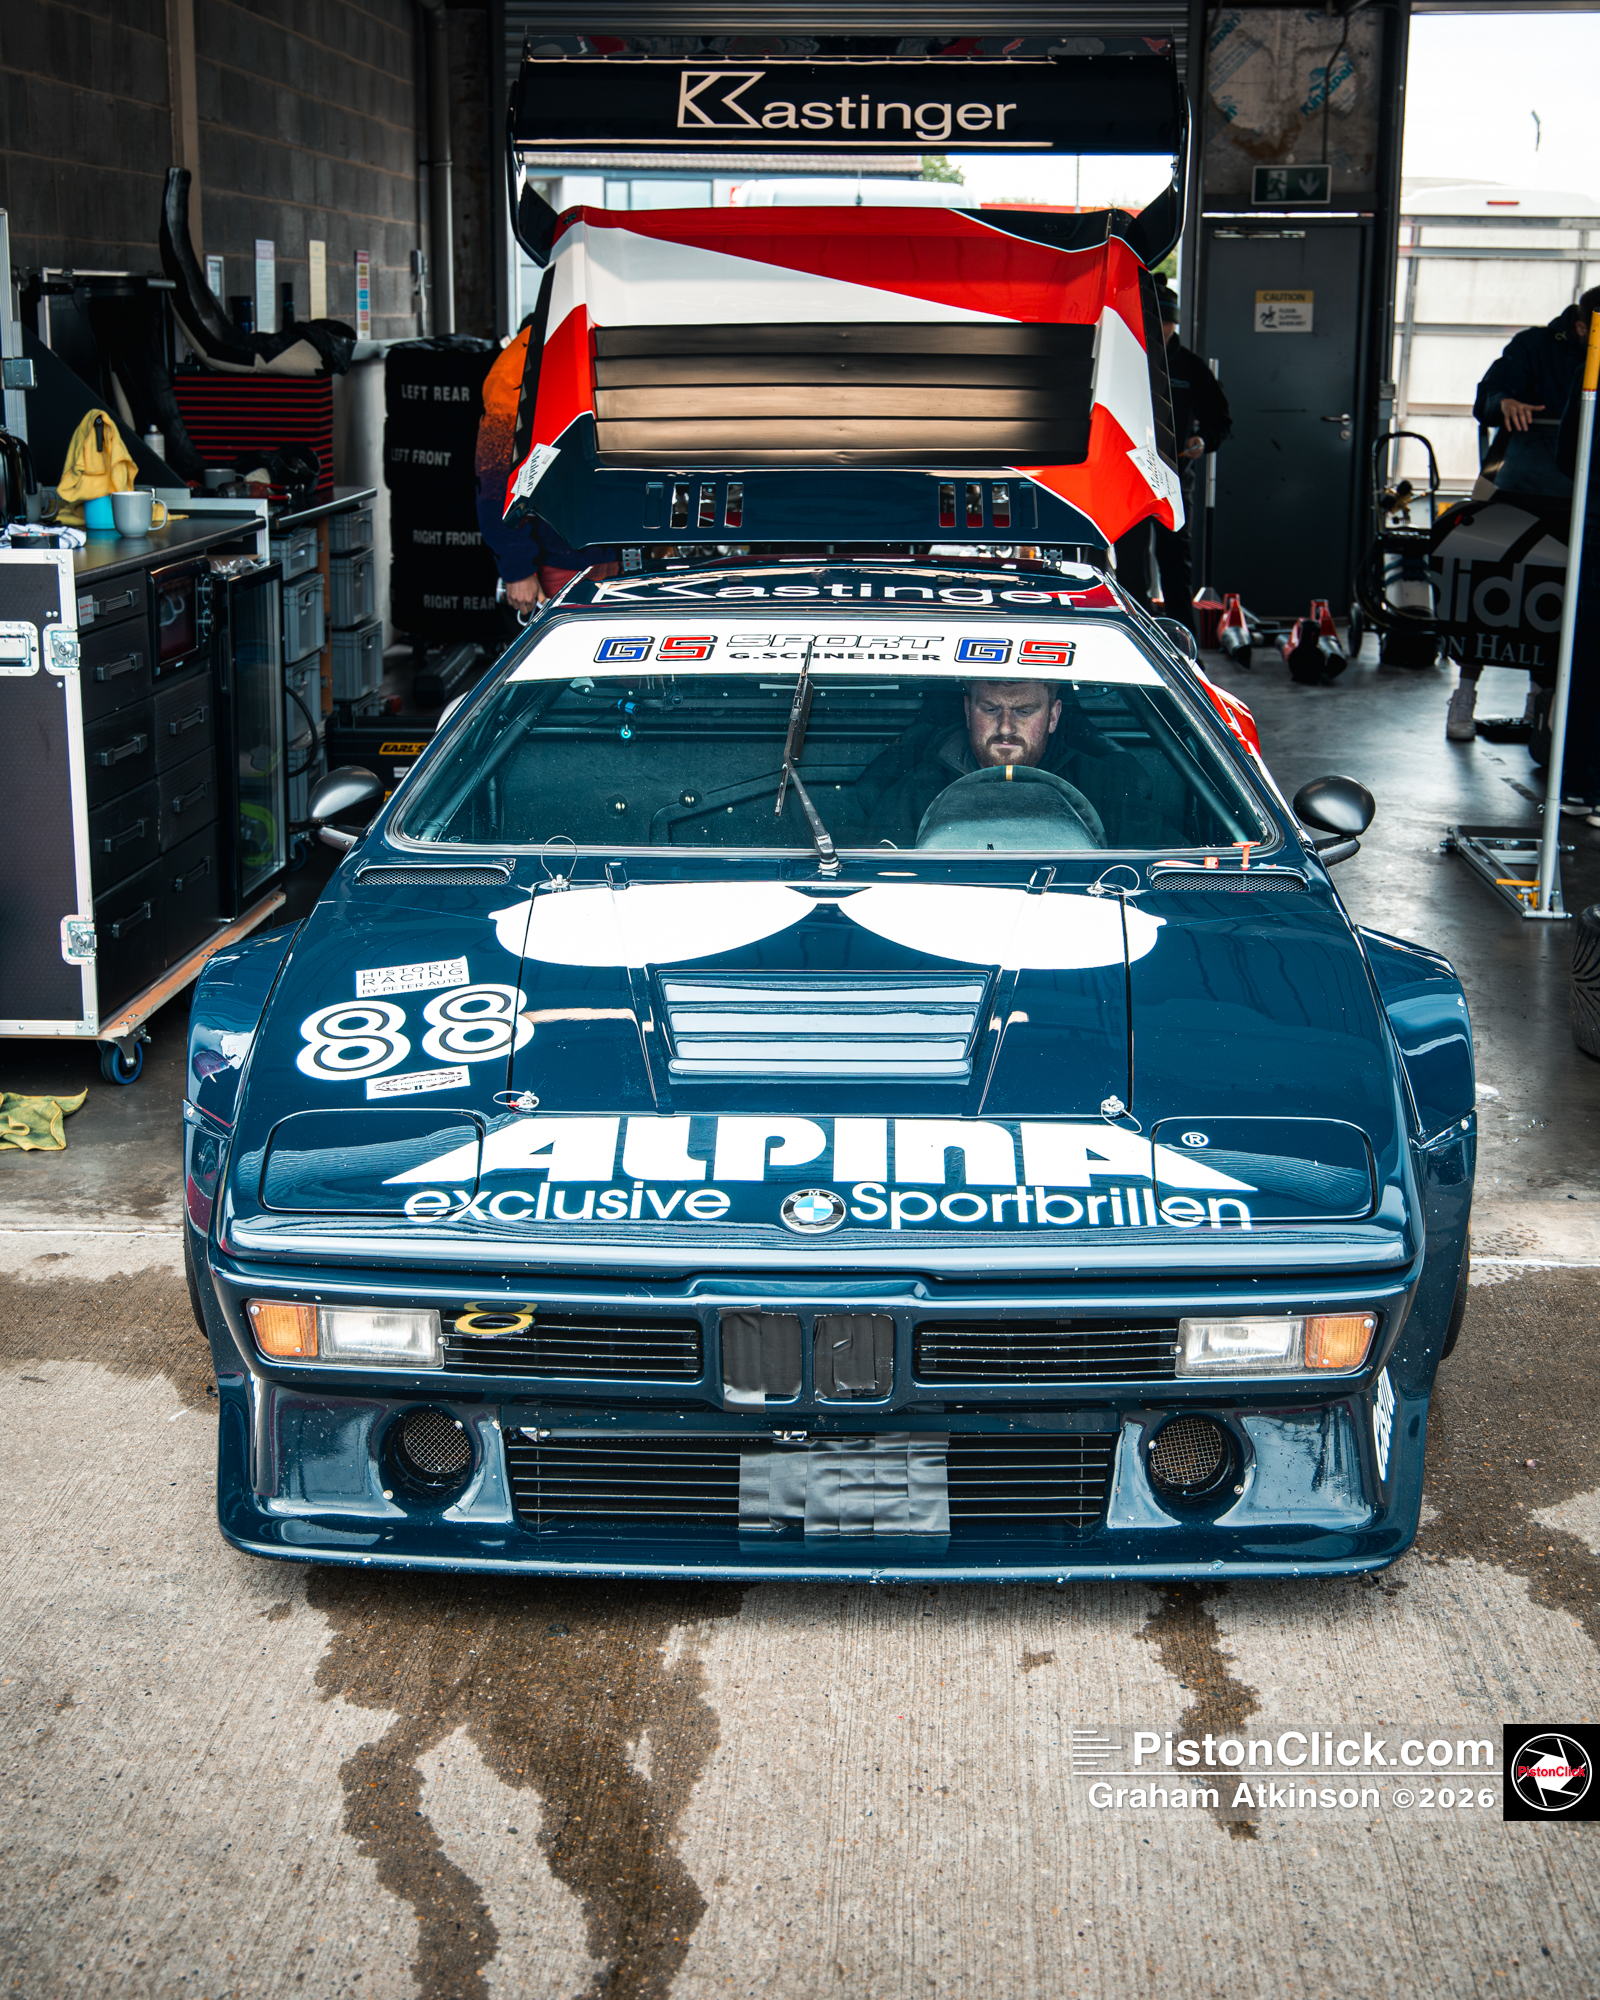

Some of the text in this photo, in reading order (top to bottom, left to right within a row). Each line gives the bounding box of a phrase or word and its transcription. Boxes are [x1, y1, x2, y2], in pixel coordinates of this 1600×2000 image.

[1263, 293, 1306, 301] CAUTION
[401, 384, 470, 401] LEFT REAR
[391, 448, 451, 466] LEFT FRONT
[413, 529, 482, 546] RIGHT FRONT
[424, 594, 496, 610] RIGHT REAR
[726, 634, 944, 649] SPORT
[1474, 632, 1545, 667] HALL
[729, 652, 942, 662] G.SCHNEIDER
[362, 961, 462, 979] HISTORIC
[363, 968, 462, 987] RACING
[362, 977, 463, 995] BY PETER AUTO
[295, 983, 535, 1081] 88
[404, 1181, 731, 1223] exclusive
[789, 1190, 840, 1203] BMW
[851, 1182, 1252, 1231] Sportbrillen
